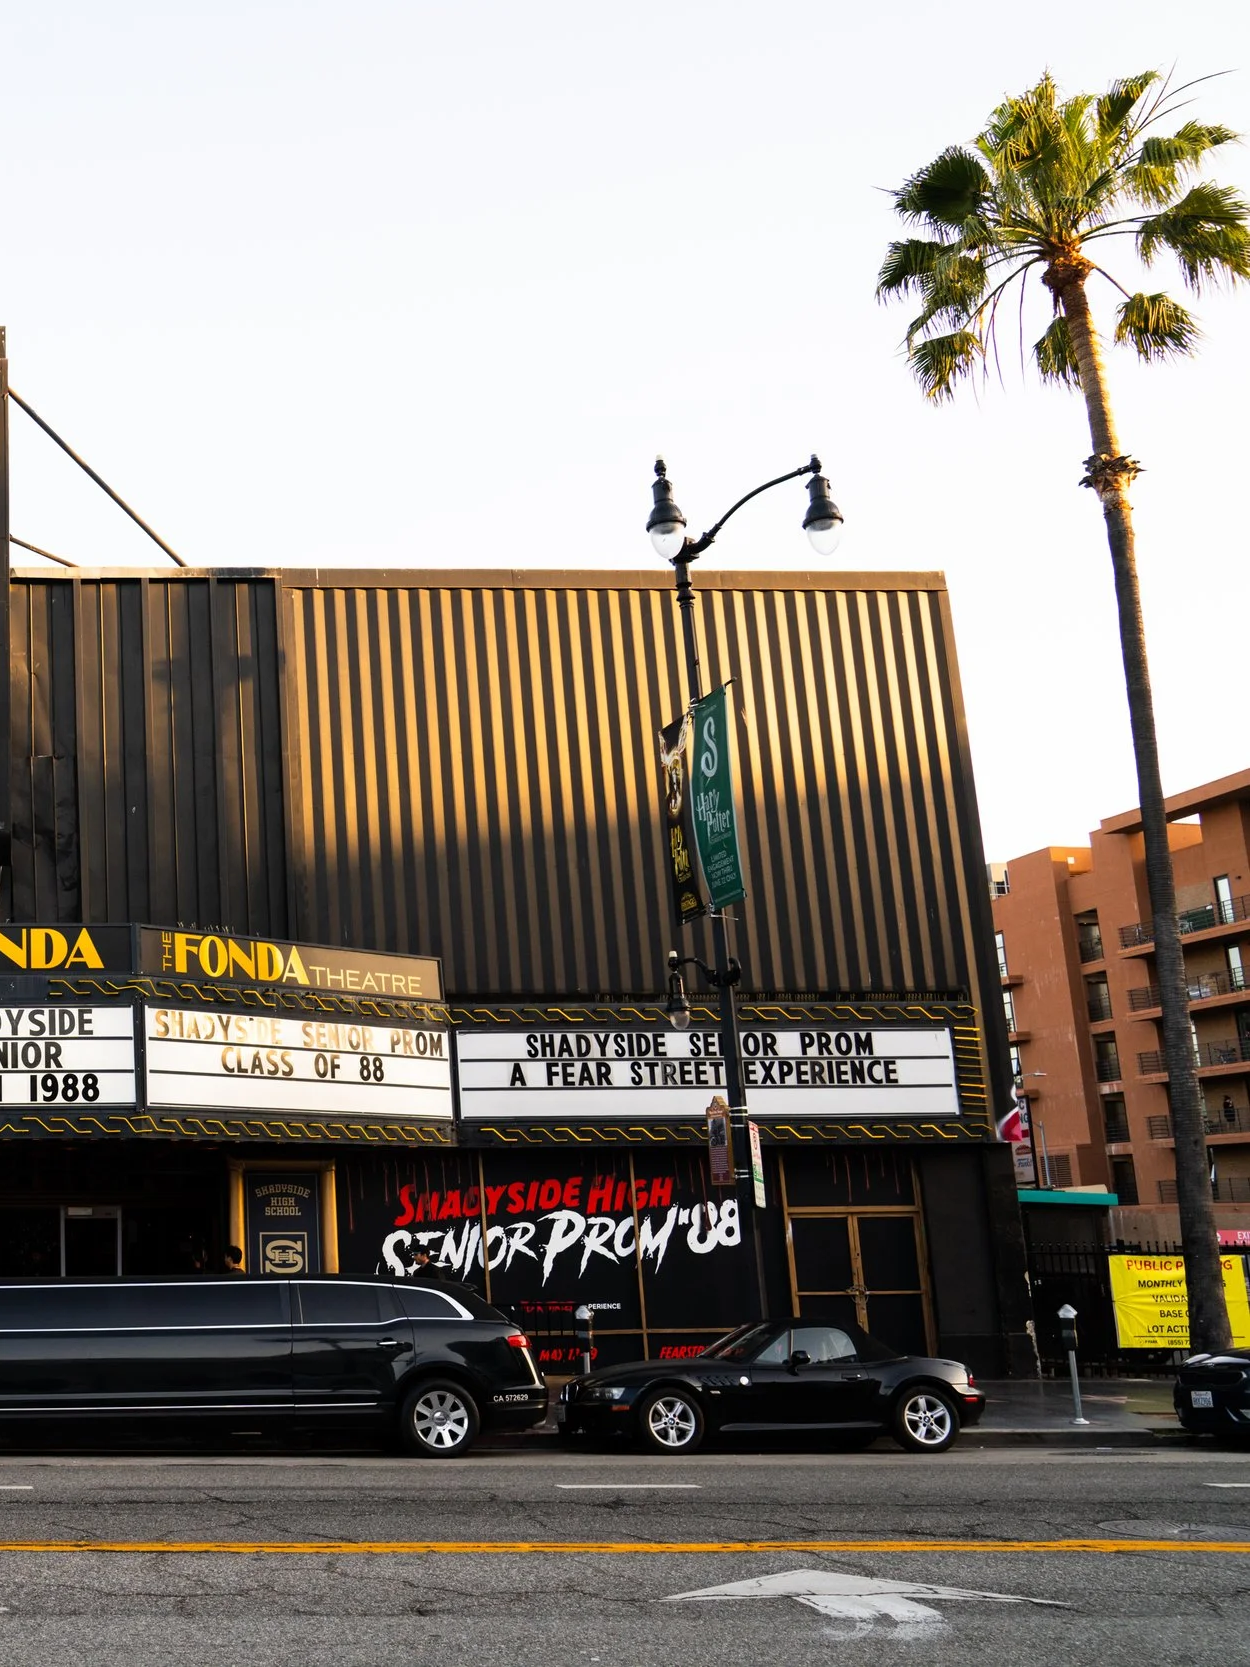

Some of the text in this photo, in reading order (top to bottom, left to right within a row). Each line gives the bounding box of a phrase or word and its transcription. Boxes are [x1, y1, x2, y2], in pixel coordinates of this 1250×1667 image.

[696, 789, 720, 821] Harry
[705, 810, 730, 842] Potter
[161, 930, 172, 972] THE
[174, 932, 422, 996] FONDA THEATRE
[155, 1010, 443, 1057] SHADYSDE SENIOR PROM
[526, 1032, 874, 1058] SHADYSIDE SEOR PROM
[221, 1046, 384, 1083] CLASS OF 88
[510, 1060, 898, 1086] A FEAR STREET EXPERIENCE
[30, 1074, 100, 1102] 1988
[254, 1184, 310, 1198] SHADYSIDE
[270, 1197, 295, 1206] HIGH
[394, 1174, 674, 1227] SHADYSIDE HIGH
[265, 1206, 302, 1216] SCHOOL
[375, 1218, 538, 1282] SENIOR
[536, 1202, 678, 1288] PROM
[1126, 1260, 1172, 1271] PUBLIC
[1138, 1280, 1182, 1288] MONTHLY
[1152, 1295, 1188, 1303] VALIDA
[1160, 1310, 1184, 1318] BASE
[506, 1394, 528, 1402] 572629
